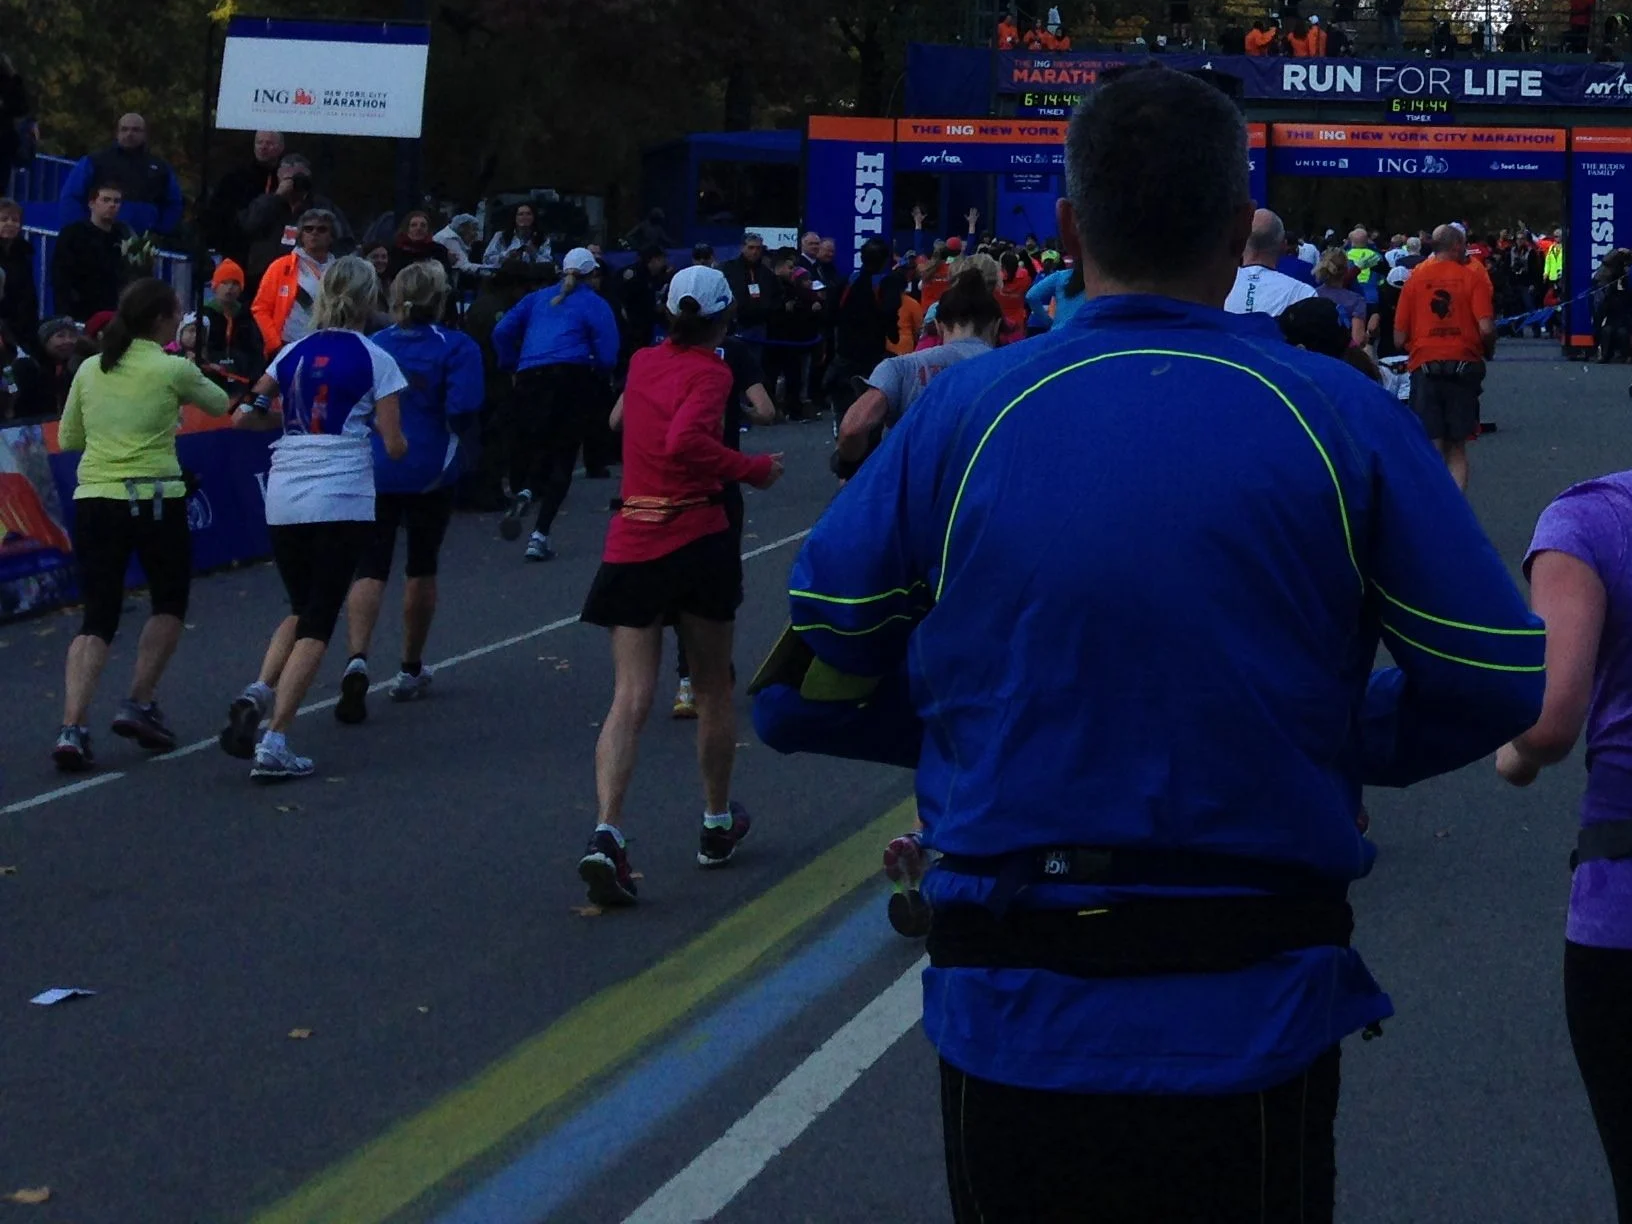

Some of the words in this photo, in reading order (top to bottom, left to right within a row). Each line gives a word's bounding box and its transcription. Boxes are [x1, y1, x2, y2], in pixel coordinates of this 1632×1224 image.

[1034, 59, 1051, 68] ING
[1013, 68, 1097, 84] MARATH
[1282, 63, 1362, 94] RUN
[1376, 66, 1452, 96] FOR
[1463, 67, 1543, 98] LIFE
[253, 88, 289, 104] ING
[323, 97, 387, 109] MARATHON
[912, 124, 941, 135] THE
[946, 124, 974, 136] ING
[979, 125, 1012, 136] NEW
[1018, 126, 1059, 136] YORK
[1286, 130, 1314, 140] THE
[1319, 130, 1347, 141] ING
[1351, 131, 1383, 141] NEW
[1388, 131, 1430, 142] YORK
[1434, 132, 1467, 143] CITY
[1472, 133, 1555, 144] MARATHON
[1010, 155, 1032, 164] ING
[1295, 160, 1337, 168] UNITED
[1377, 157, 1418, 174] ING
